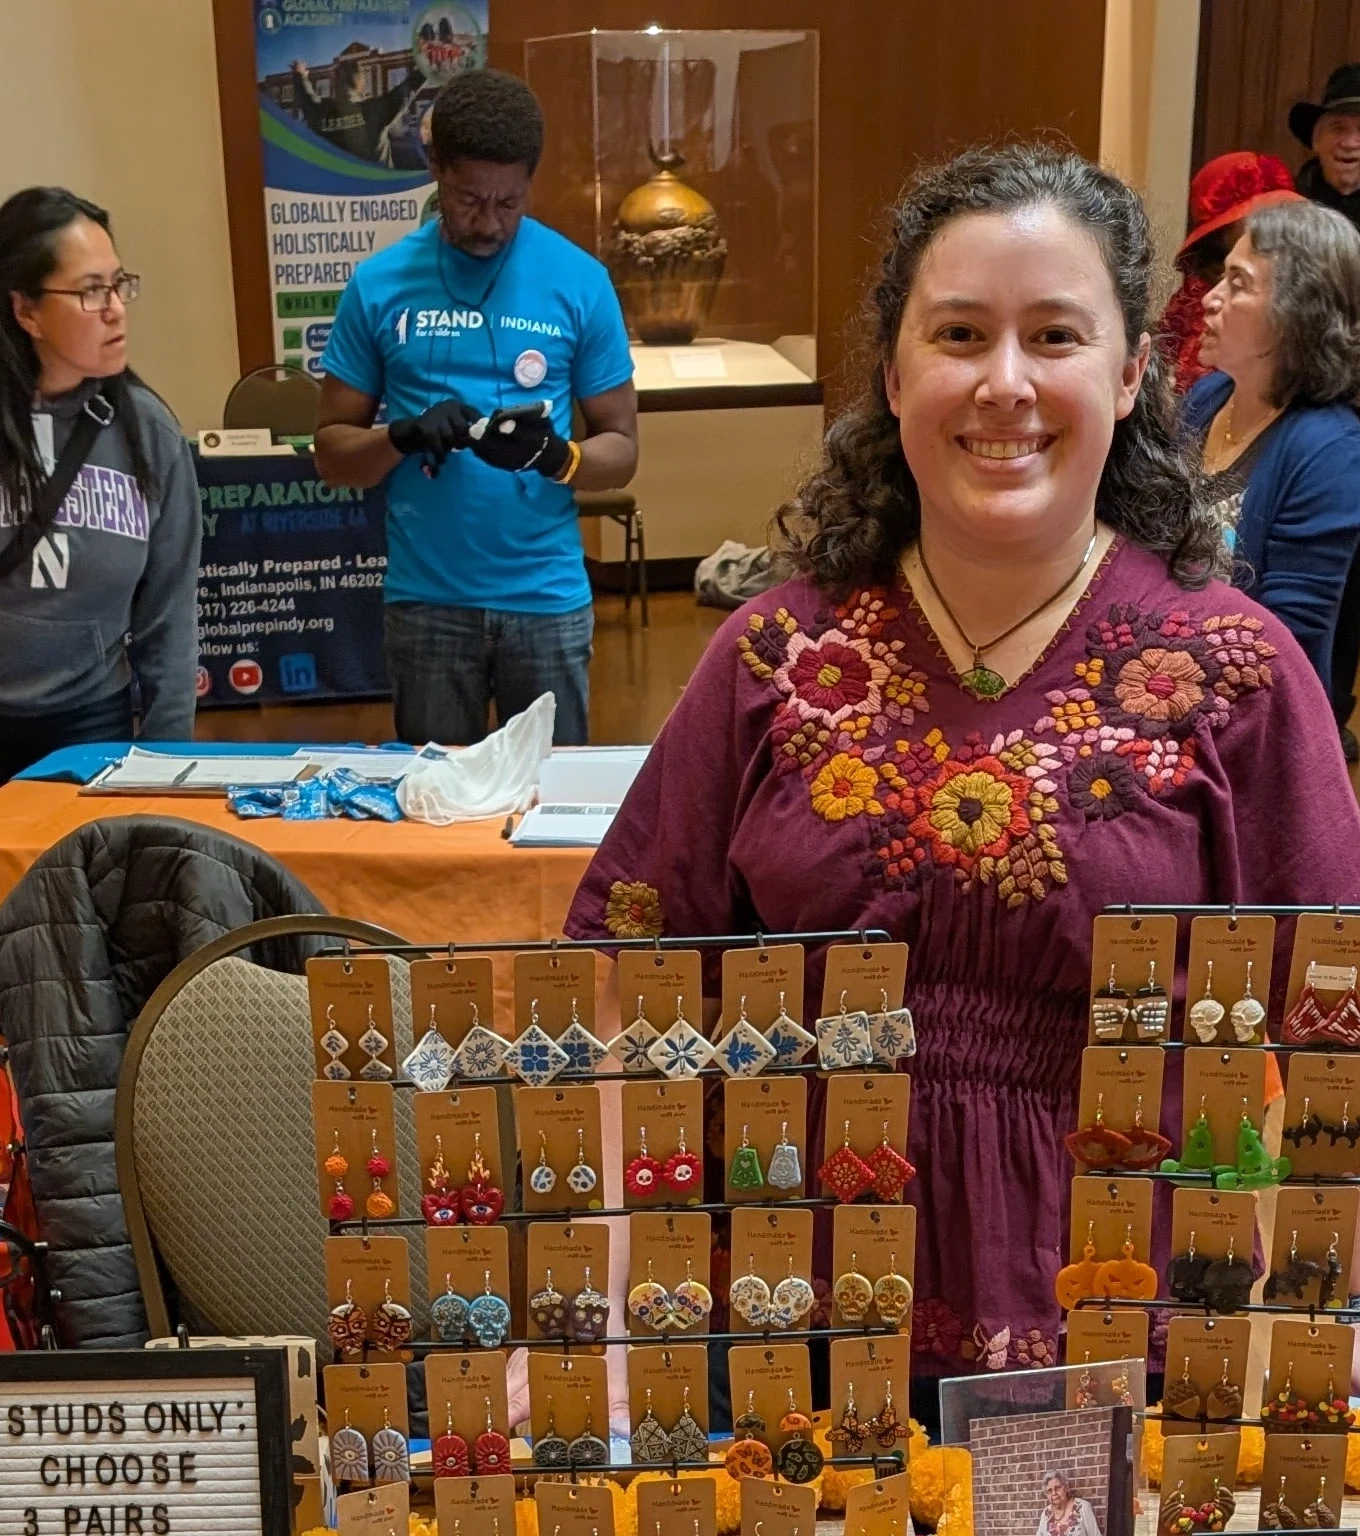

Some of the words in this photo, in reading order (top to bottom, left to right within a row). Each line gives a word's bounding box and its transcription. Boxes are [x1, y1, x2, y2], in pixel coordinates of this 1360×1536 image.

[271, 201, 347, 224] GLOBALLY
[350, 199, 418, 222] ENGAGED
[272, 230, 376, 255] HOLISTICALLY
[275, 262, 352, 285] PREPARED
[415, 309, 483, 328] STAND
[500, 315, 562, 338] INDIANA
[30, 532, 70, 589] N
[197, 559, 258, 579] stically
[263, 555, 341, 575] Prepared
[356, 553, 388, 569] Lea
[220, 578, 317, 597] Indianapolis,
[319, 575, 337, 590] IN
[340, 573, 384, 588] 46202
[230, 597, 295, 616] 226-4244
[197, 642, 233, 656] ollow
[7, 1400, 127, 1437] STUDS
[144, 1400, 247, 1433] ONLY:
[40, 1451, 198, 1487] CHOOSE
[64, 1503, 171, 1536] PAIRS
